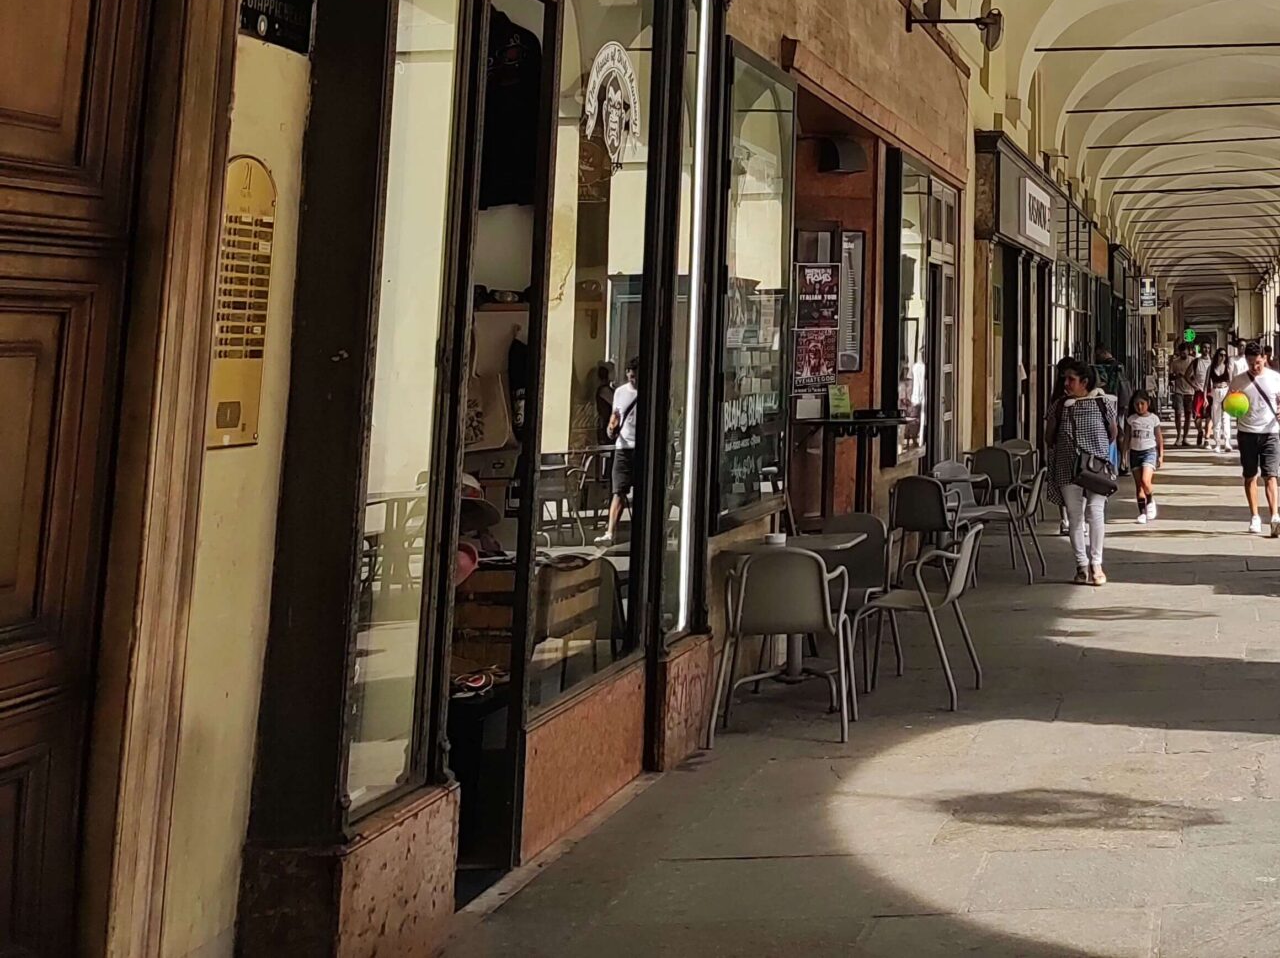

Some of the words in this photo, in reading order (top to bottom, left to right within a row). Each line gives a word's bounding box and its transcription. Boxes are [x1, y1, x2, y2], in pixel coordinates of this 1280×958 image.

[595, 52, 610, 79] House
[610, 46, 617, 67] of
[241, 161, 253, 191] 21
[724, 398, 742, 433] BLAH
